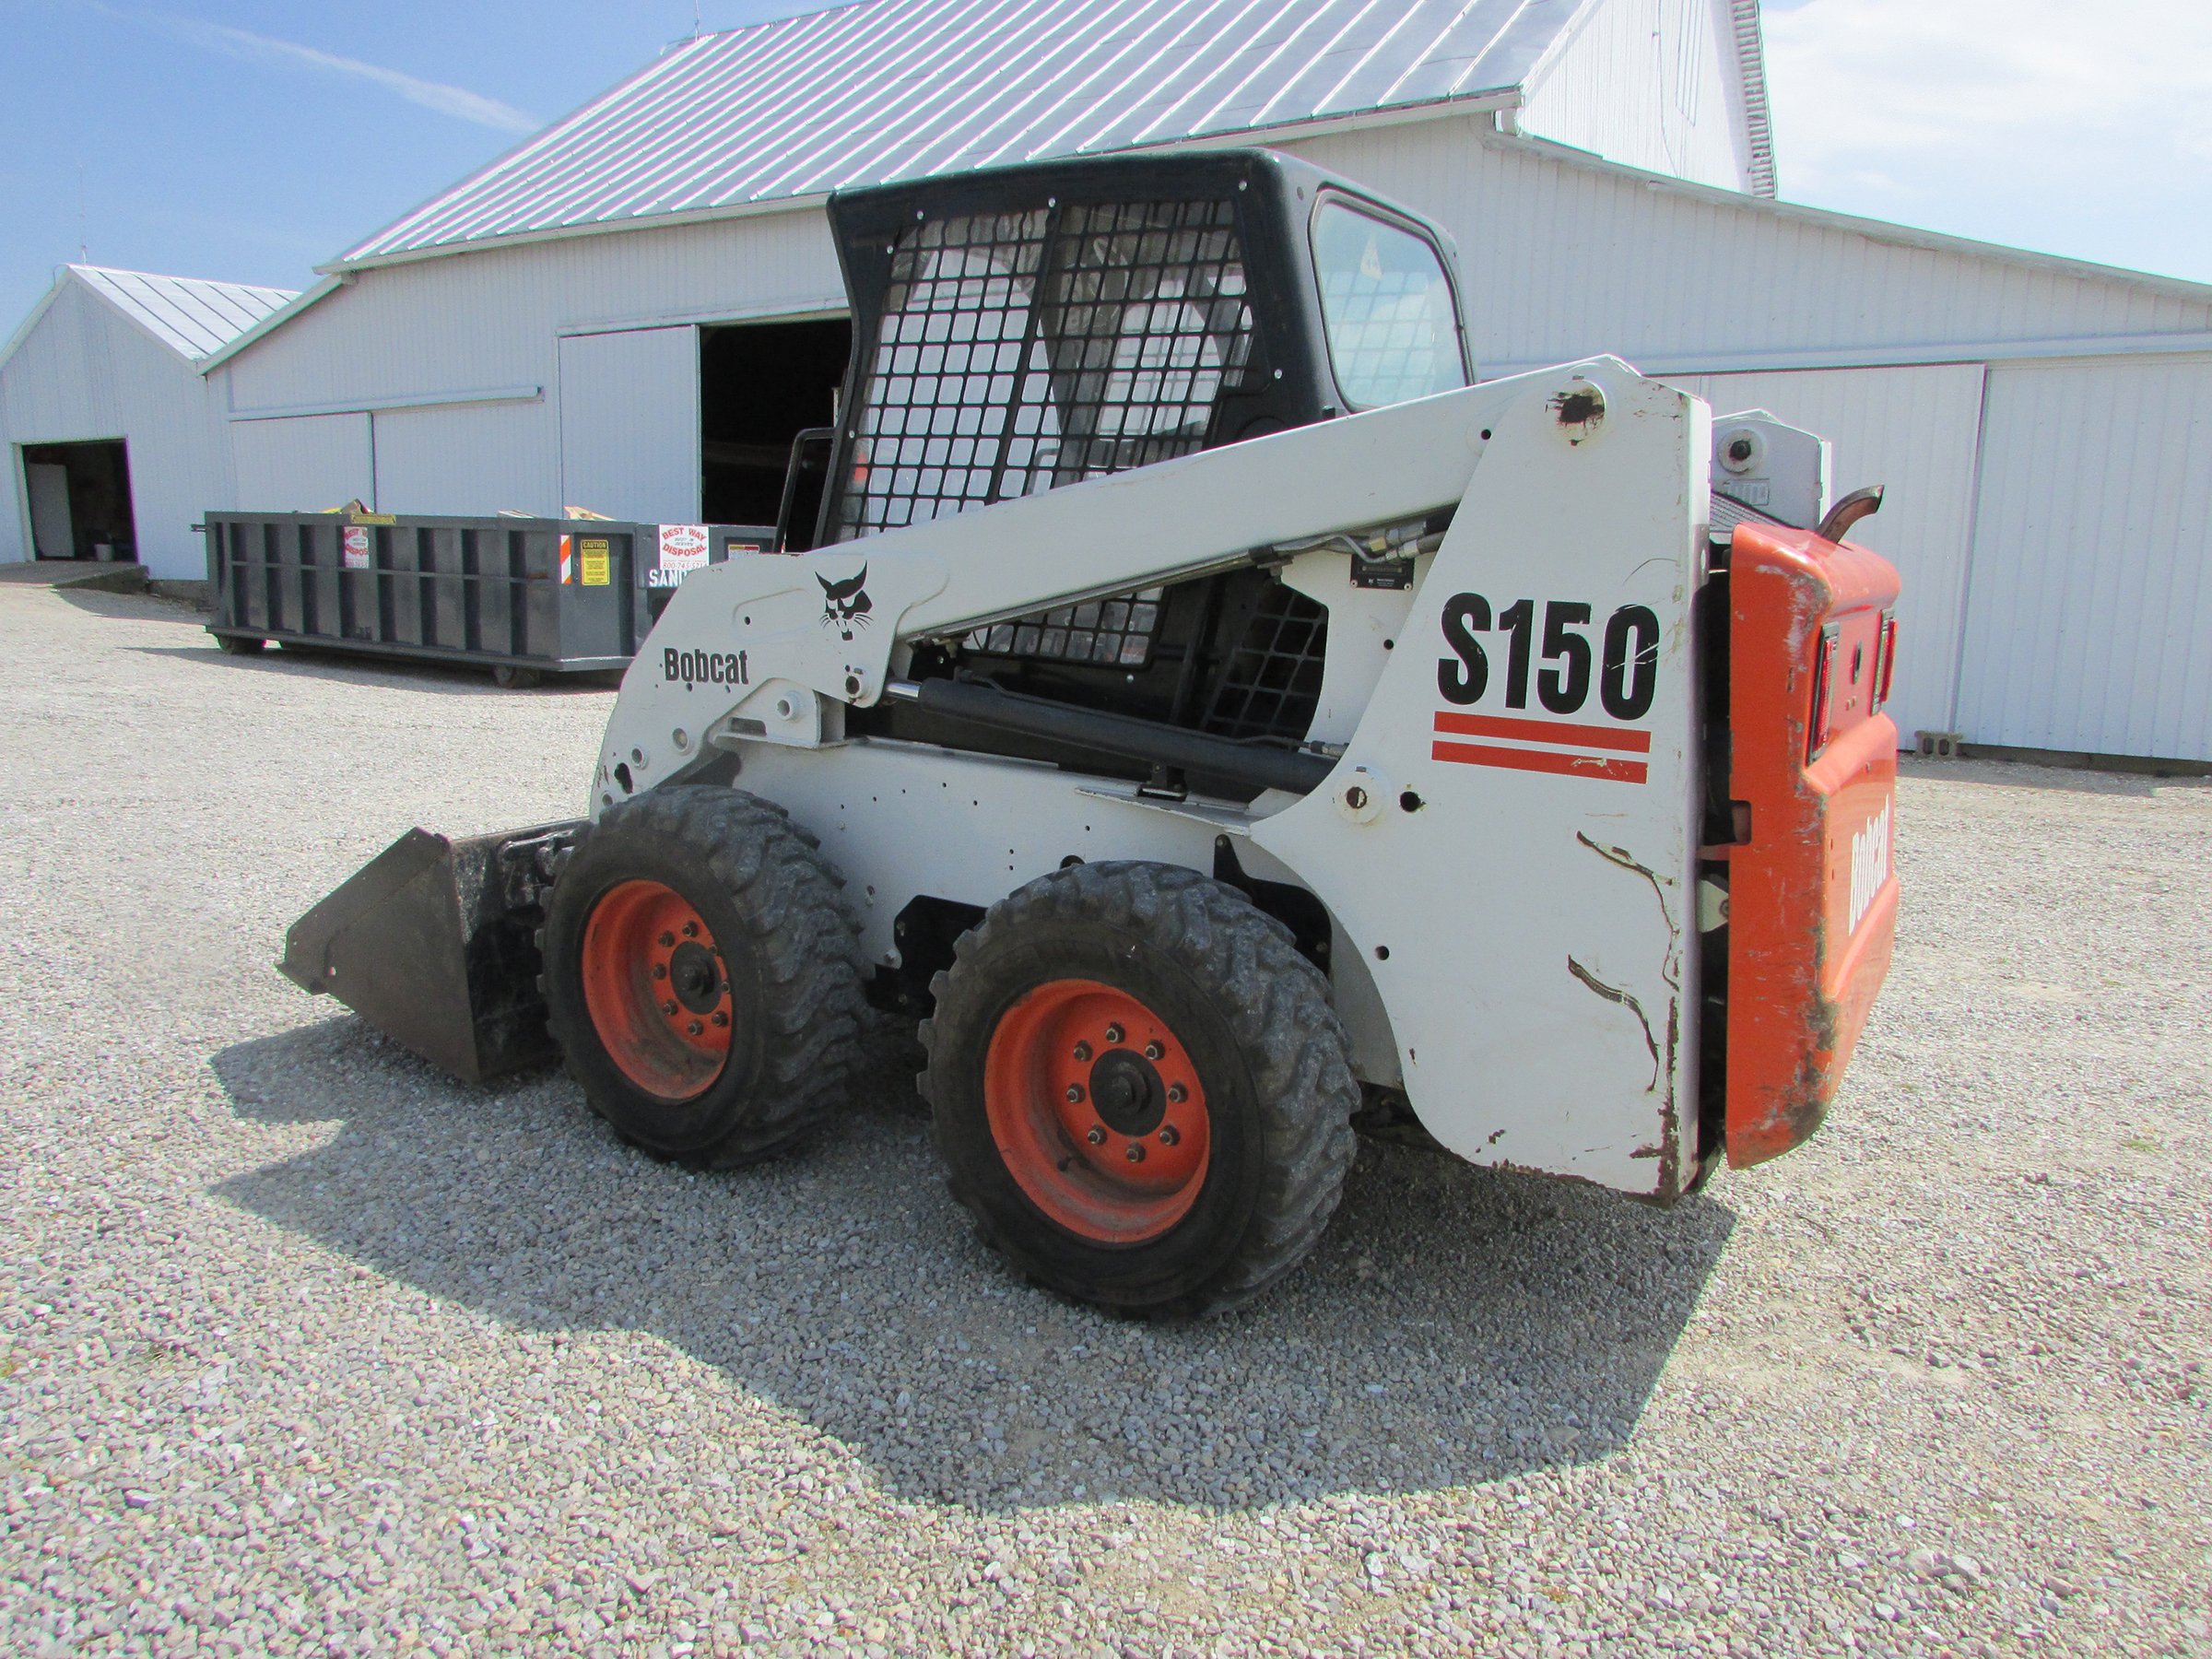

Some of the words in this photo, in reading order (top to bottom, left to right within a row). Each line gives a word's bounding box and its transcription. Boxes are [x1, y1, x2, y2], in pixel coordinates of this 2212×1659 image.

[663, 527, 684, 539] BEST
[688, 528, 707, 541] WAY
[345, 544, 369, 555] DISPOS
[663, 543, 707, 557] DISPOSAL
[665, 648, 749, 685] Bobcat
[1437, 592, 1660, 721] S150
[1849, 794, 1889, 937] Bobcat
